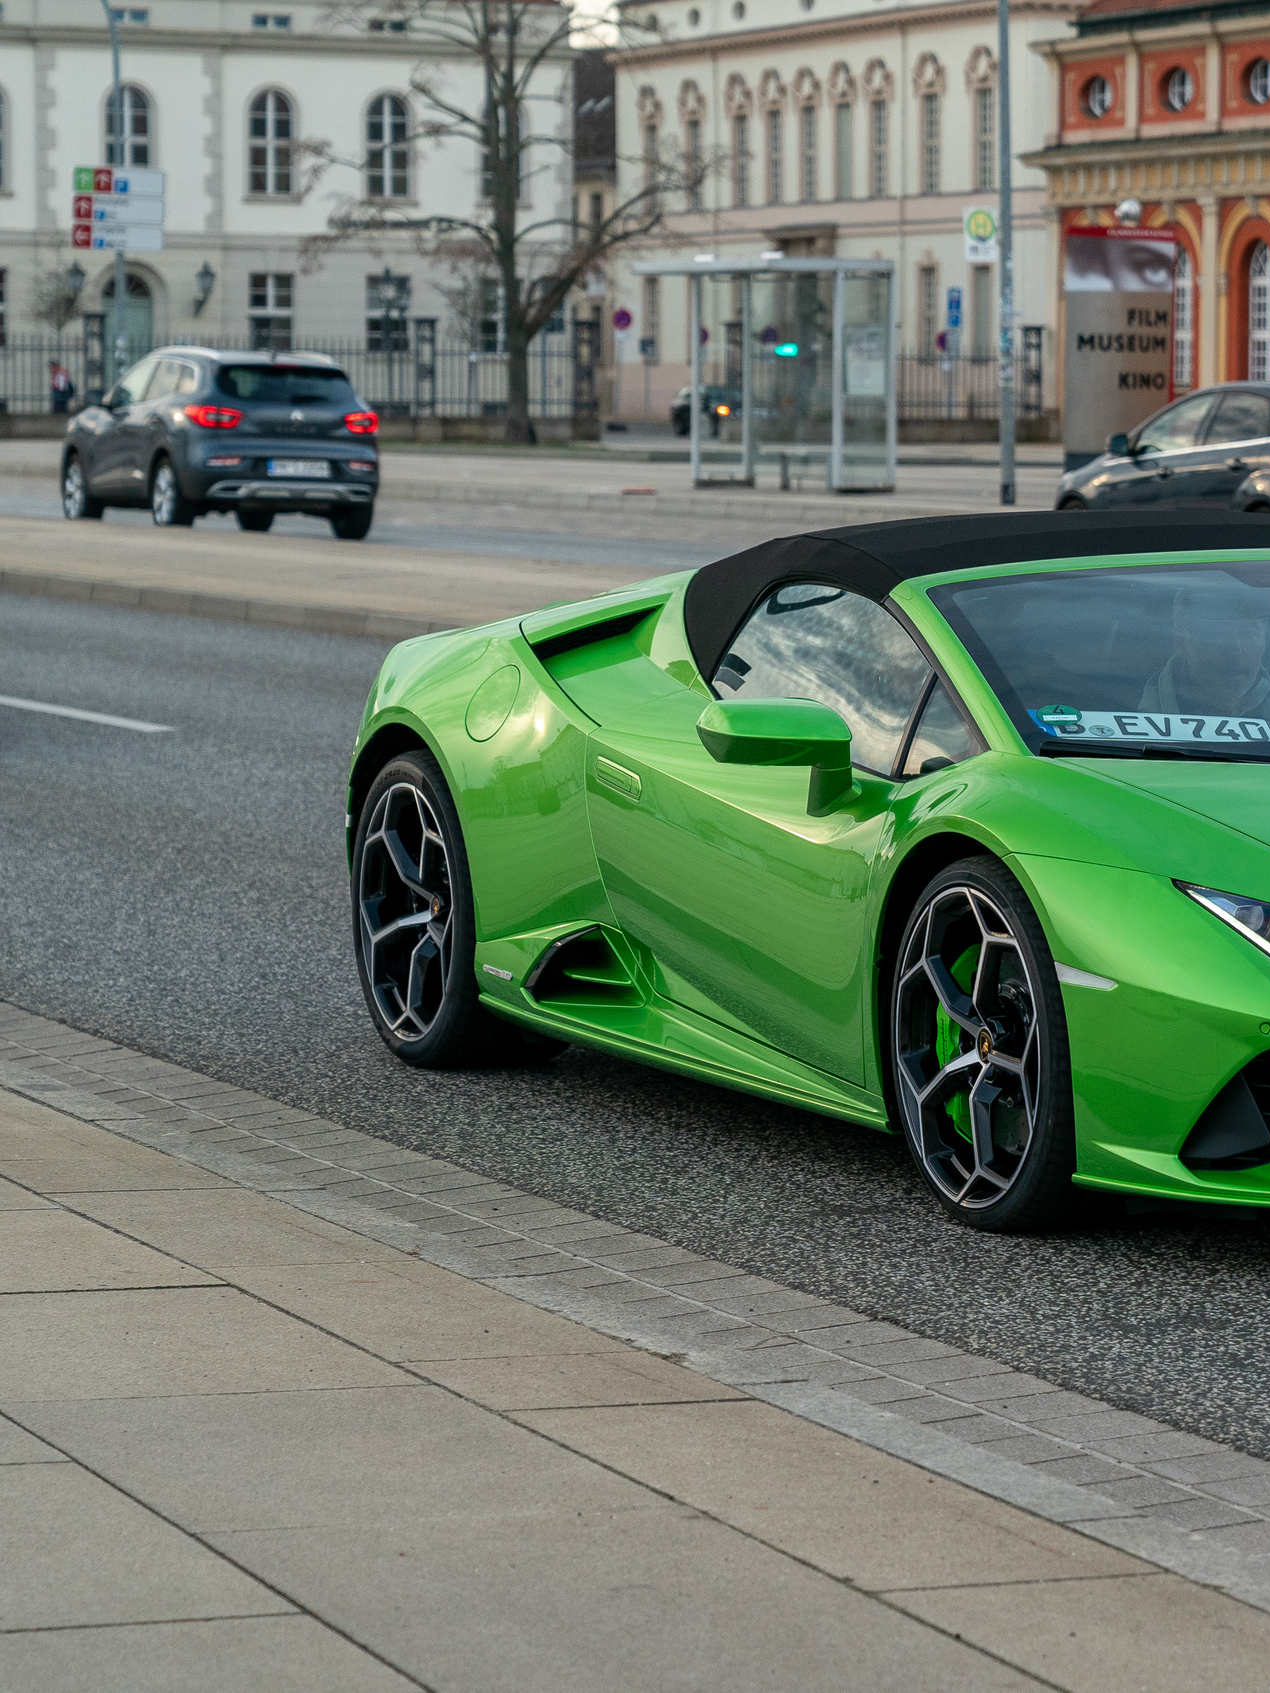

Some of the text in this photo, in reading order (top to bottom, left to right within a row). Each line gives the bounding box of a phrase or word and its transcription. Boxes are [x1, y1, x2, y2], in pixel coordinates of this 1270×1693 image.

[1127, 309, 1167, 327] FILM
[1077, 333, 1166, 353] MUSEUM
[1118, 372, 1165, 389] KINO
[1052, 706, 1065, 715] 4
